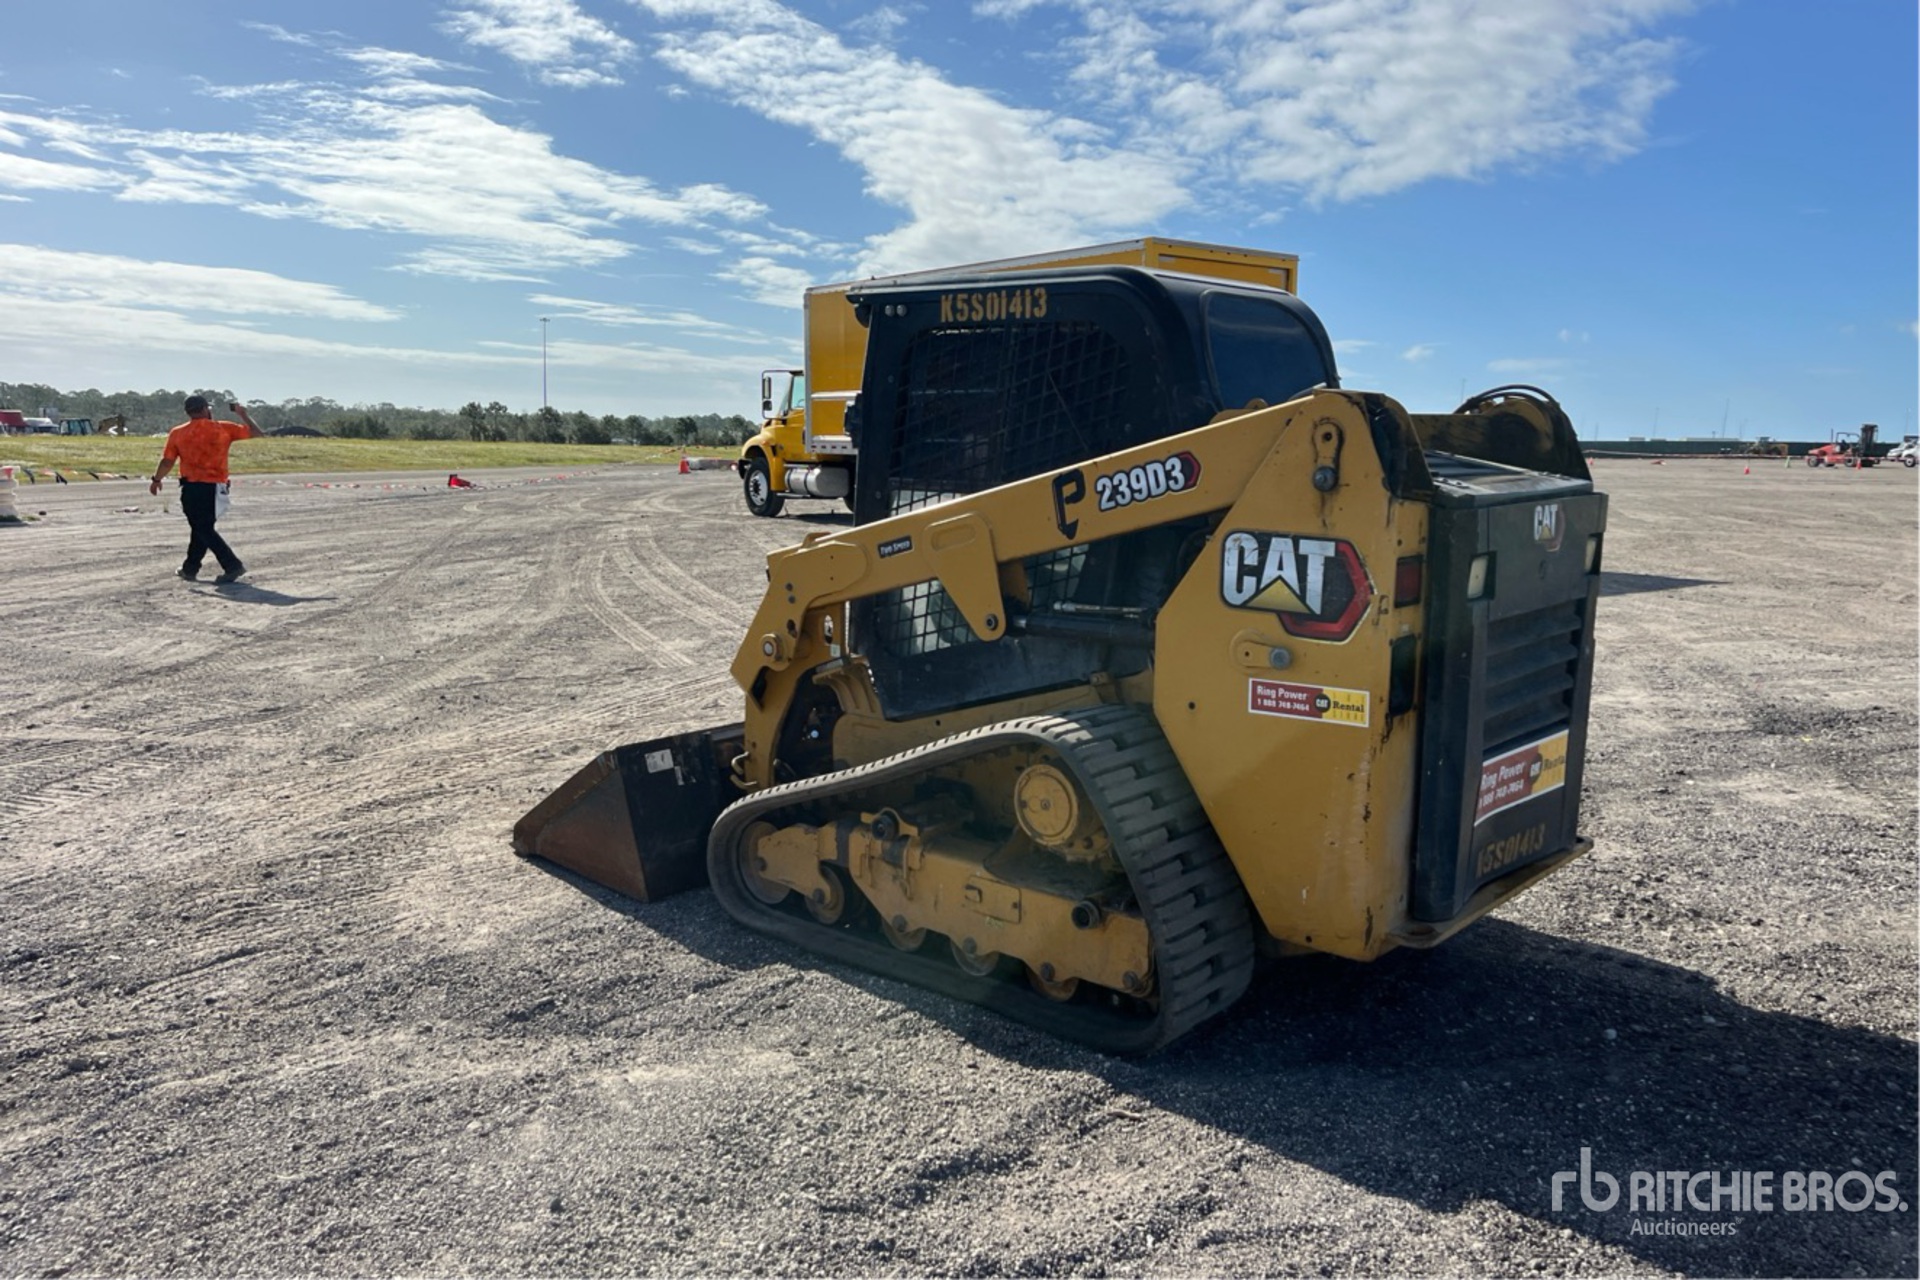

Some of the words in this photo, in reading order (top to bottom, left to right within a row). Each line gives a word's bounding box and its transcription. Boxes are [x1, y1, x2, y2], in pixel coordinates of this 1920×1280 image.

[941, 287, 1047, 323] K5S01413
[1096, 456, 1186, 511] 239D3
[1534, 504, 1558, 541] CAT
[1222, 532, 1336, 615] CAT
[1257, 685, 1277, 698] Ring
[1278, 688, 1308, 700] Power
[1315, 698, 1329, 708] CAT
[1332, 701, 1365, 713] Rental
[1481, 772, 1498, 790] Ring
[1499, 761, 1526, 782] Power
